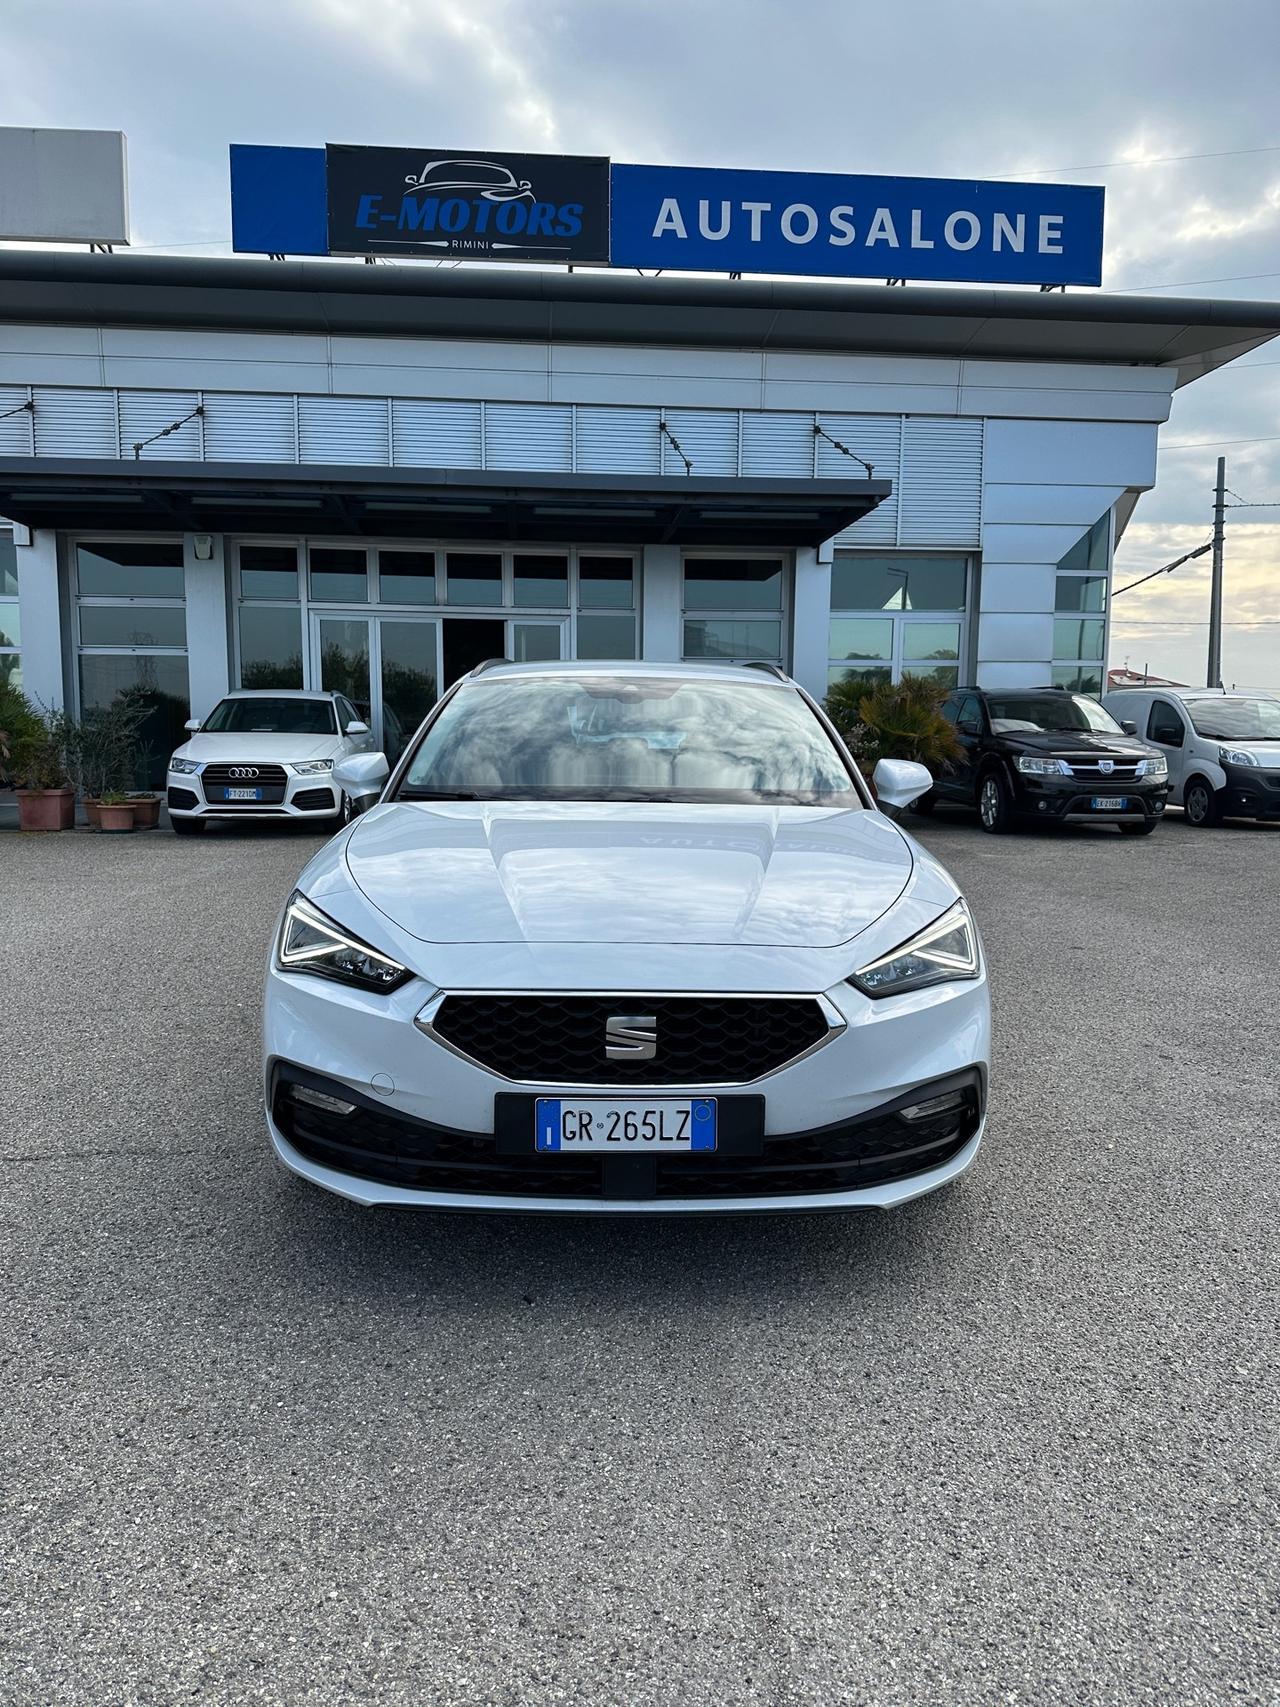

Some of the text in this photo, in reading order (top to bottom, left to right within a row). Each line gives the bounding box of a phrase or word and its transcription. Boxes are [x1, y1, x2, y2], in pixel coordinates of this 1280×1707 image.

[355, 194, 584, 238] E-MOTORS
[652, 198, 1064, 254] AUTOSALONE
[452, 239, 490, 250] RIMINI
[562, 1110, 593, 1141] GR
[606, 1110, 691, 1141] 265LZ
